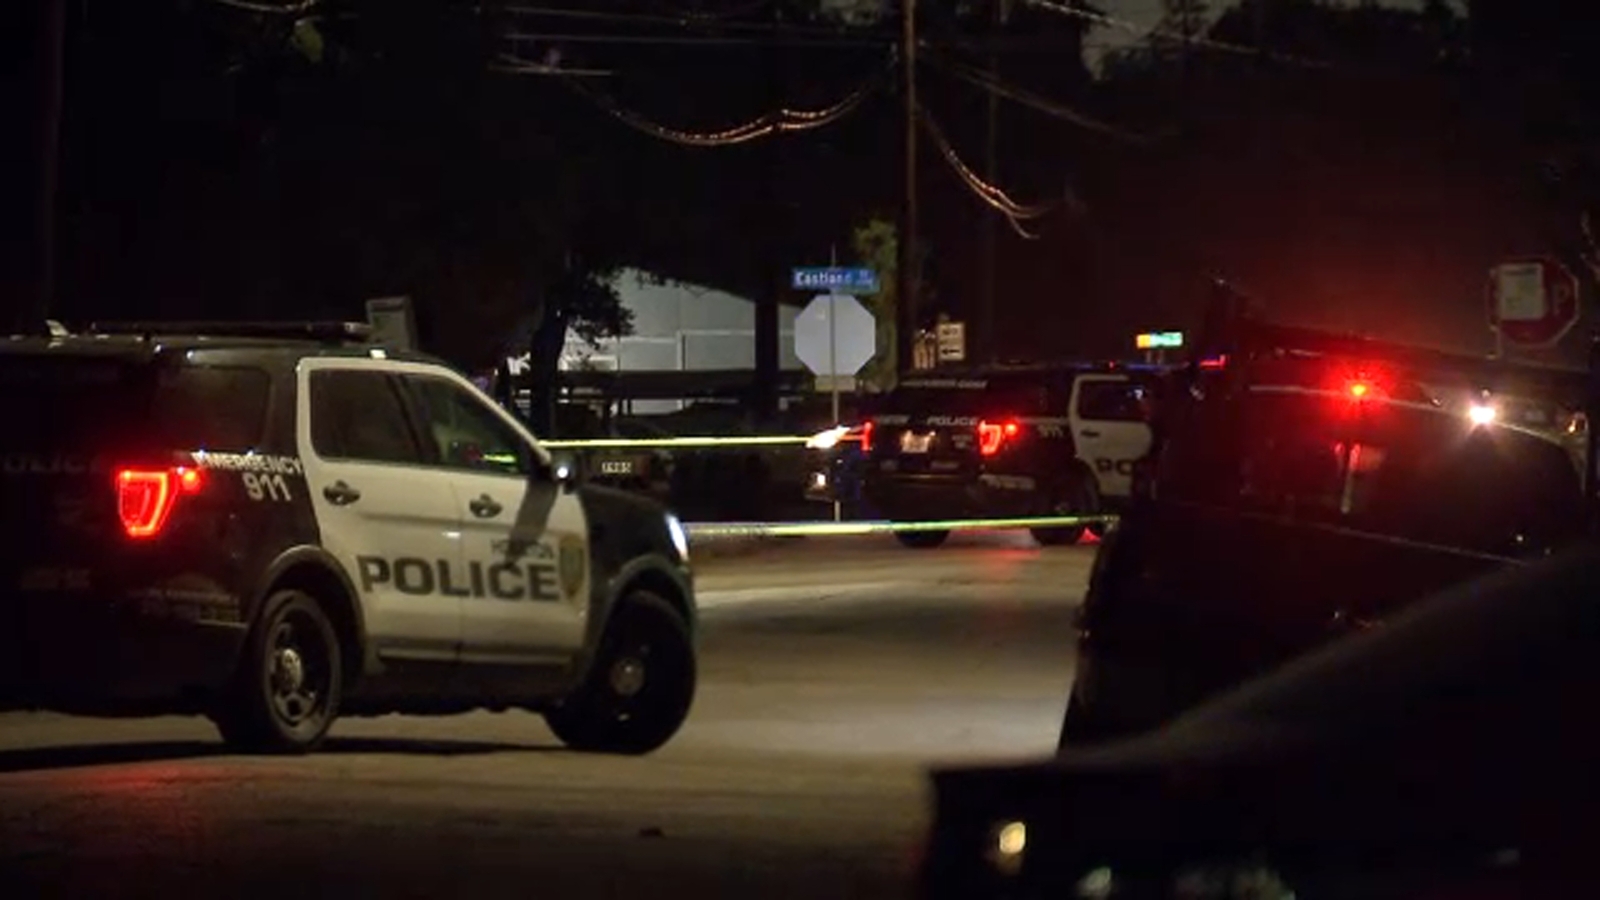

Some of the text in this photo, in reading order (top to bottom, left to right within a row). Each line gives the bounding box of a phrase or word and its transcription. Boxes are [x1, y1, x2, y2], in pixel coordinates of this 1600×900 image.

[794, 271, 853, 286] Eastland
[926, 415, 979, 426] POLICE
[1, 453, 103, 474] OLICE
[242, 471, 291, 501] 911
[356, 554, 560, 602] POLICE
